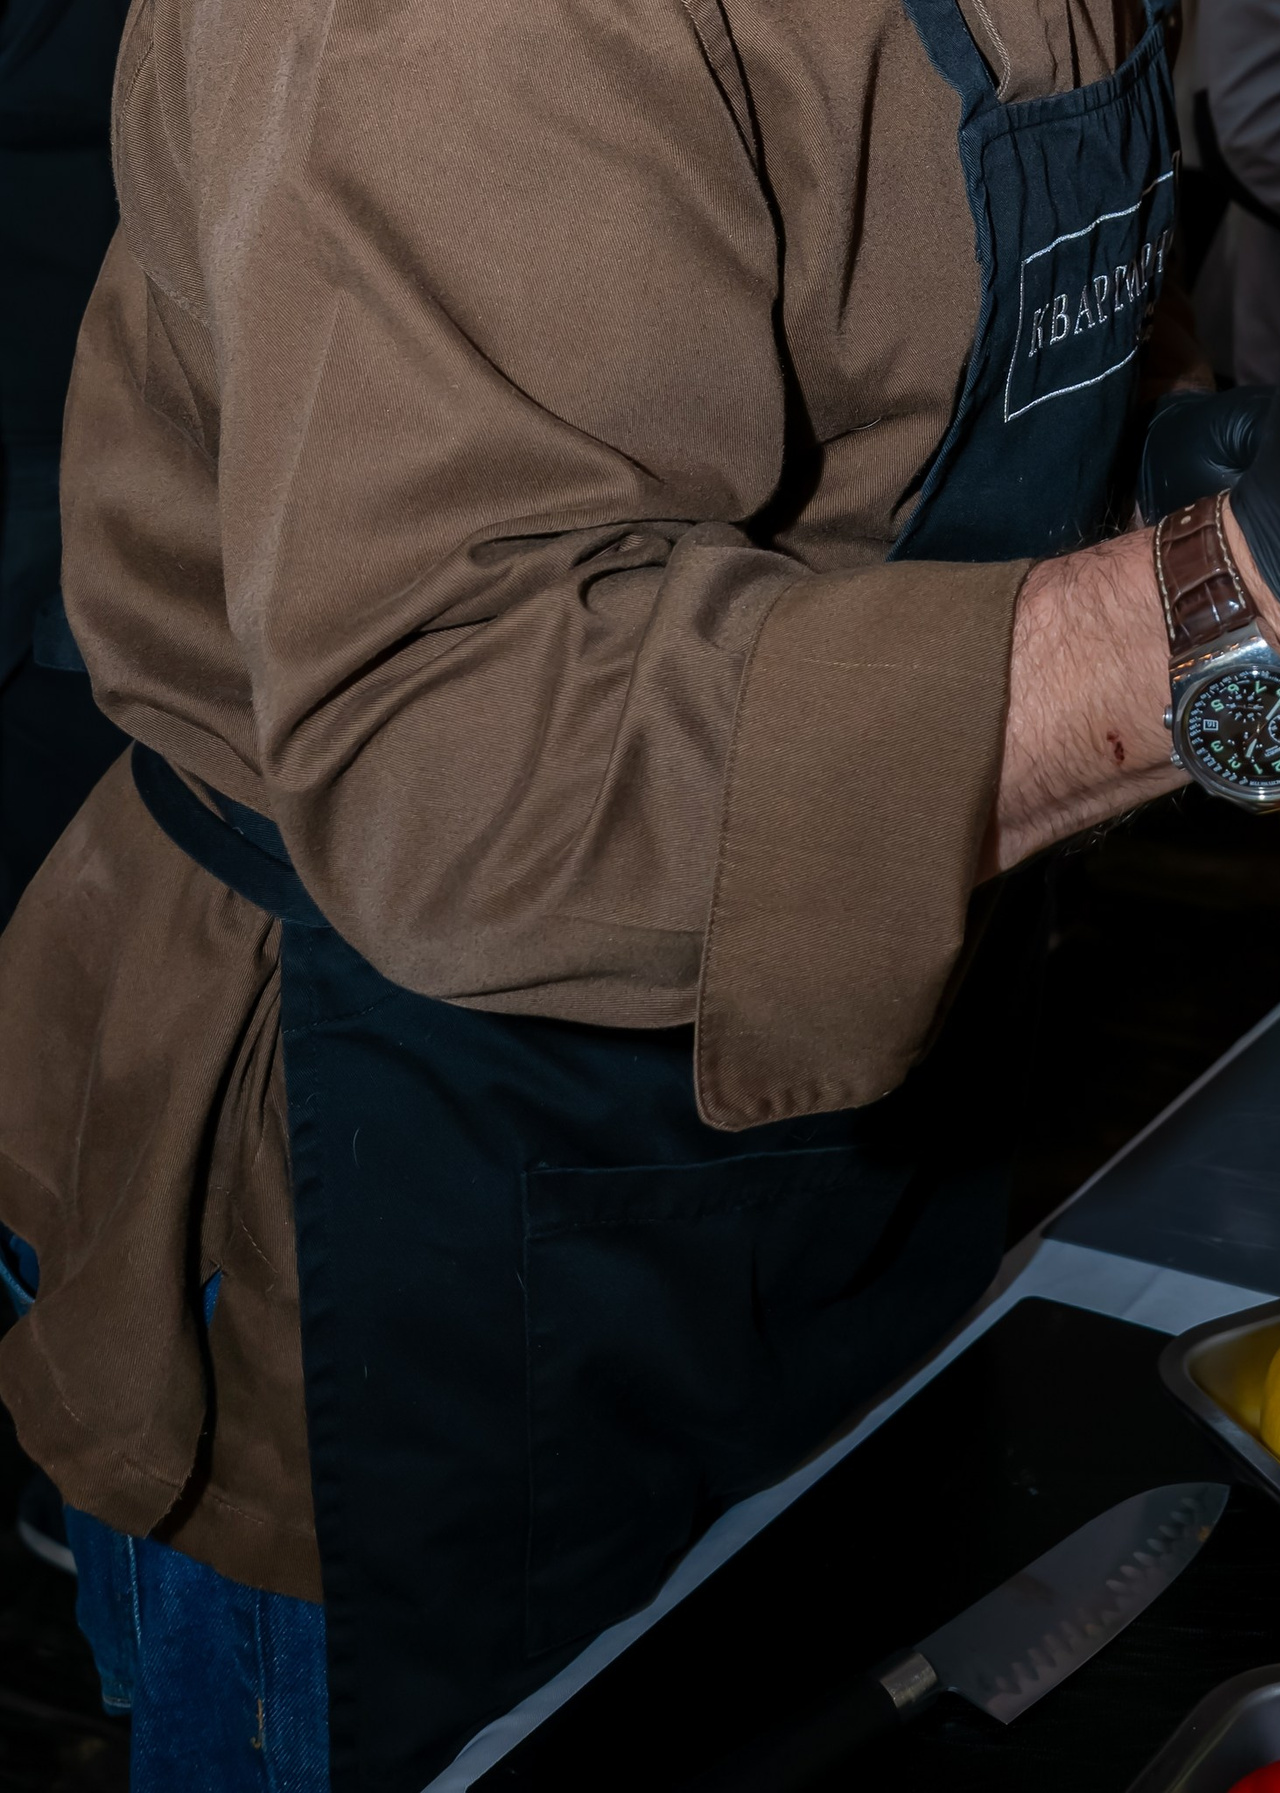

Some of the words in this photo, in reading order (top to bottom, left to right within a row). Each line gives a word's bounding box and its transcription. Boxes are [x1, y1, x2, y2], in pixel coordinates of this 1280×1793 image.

[1211, 699, 1225, 712] 5
[1210, 740, 1224, 752] 3
[1255, 760, 1263, 774] 1
